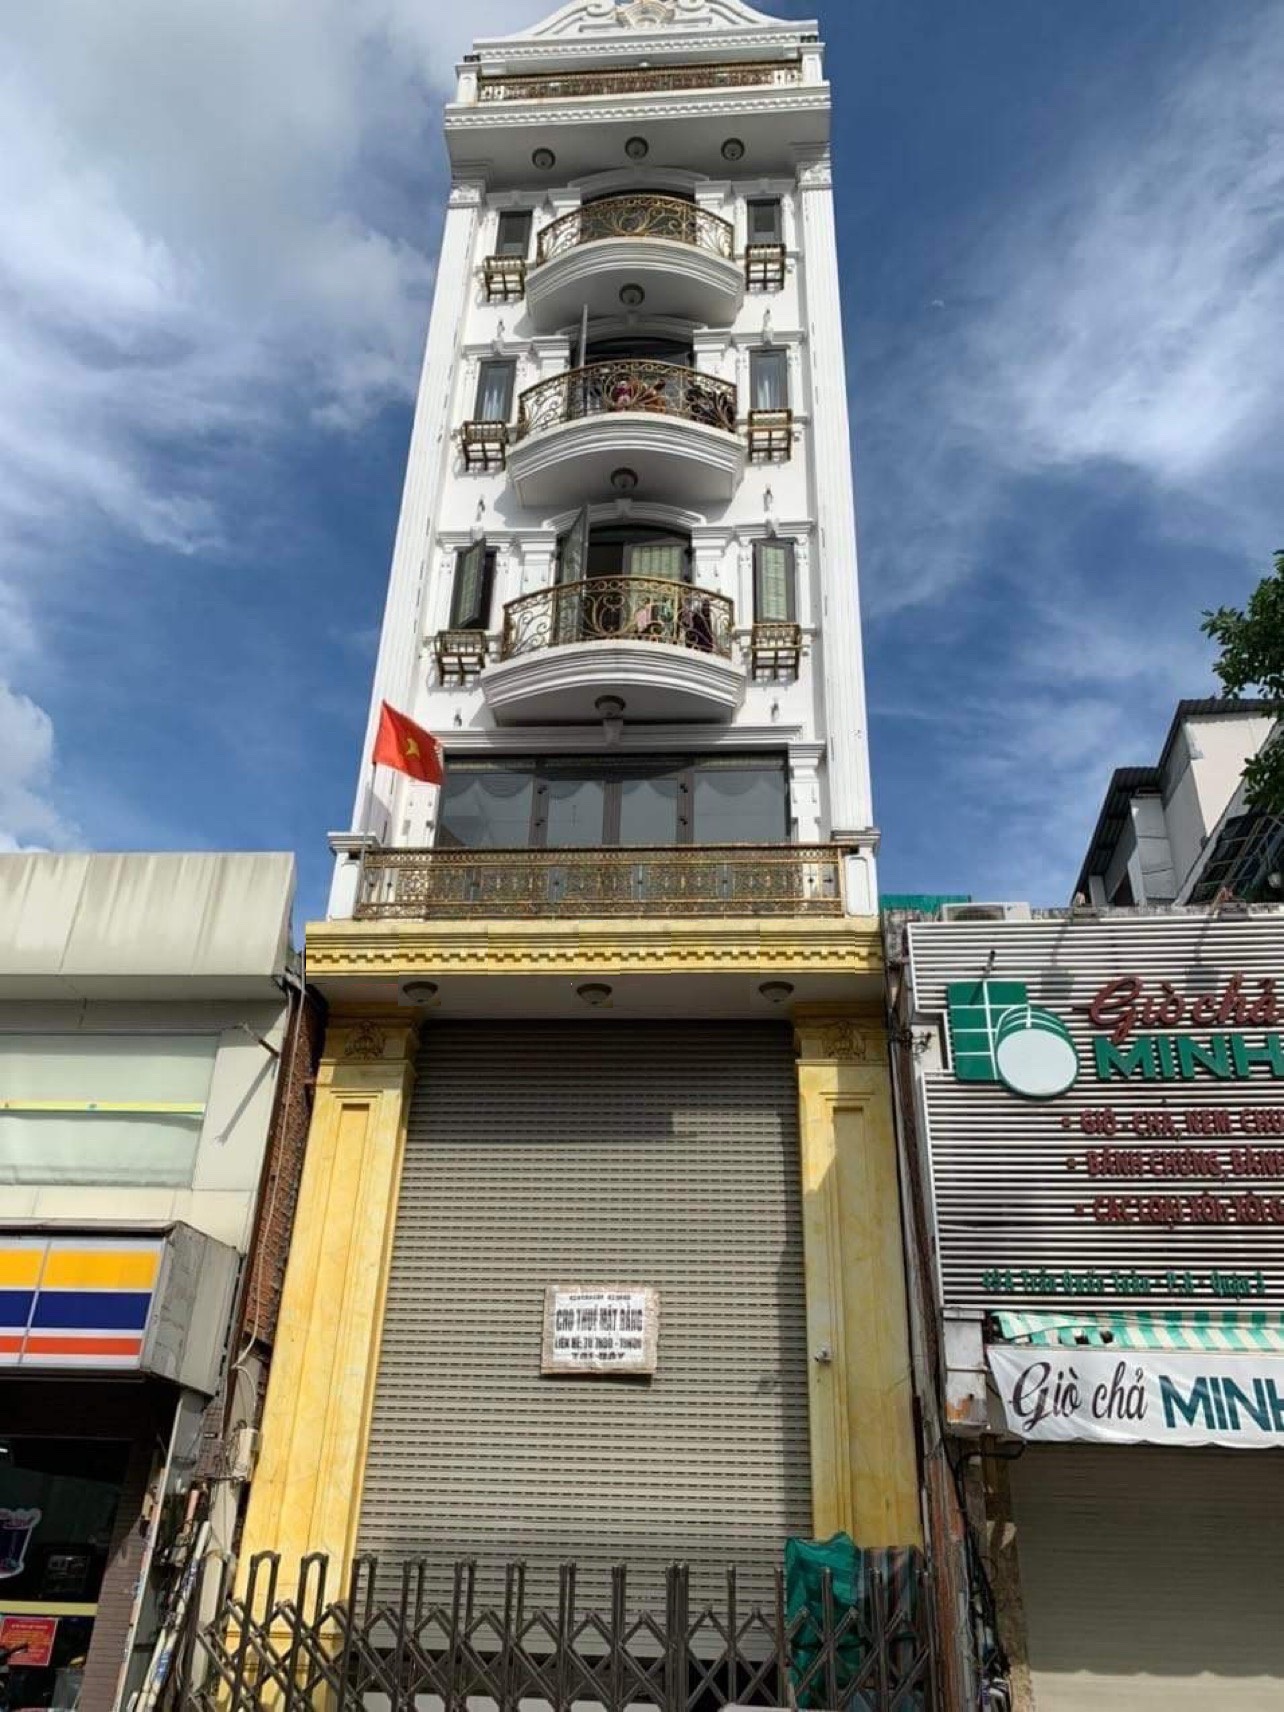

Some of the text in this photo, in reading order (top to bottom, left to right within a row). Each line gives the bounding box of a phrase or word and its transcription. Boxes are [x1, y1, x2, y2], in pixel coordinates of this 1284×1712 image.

[1089, 971, 1284, 1044] Giò chả
[1094, 1033, 1284, 1081] MINH
[1008, 1361, 1082, 1432] Giò
[1092, 1360, 1149, 1421] chả
